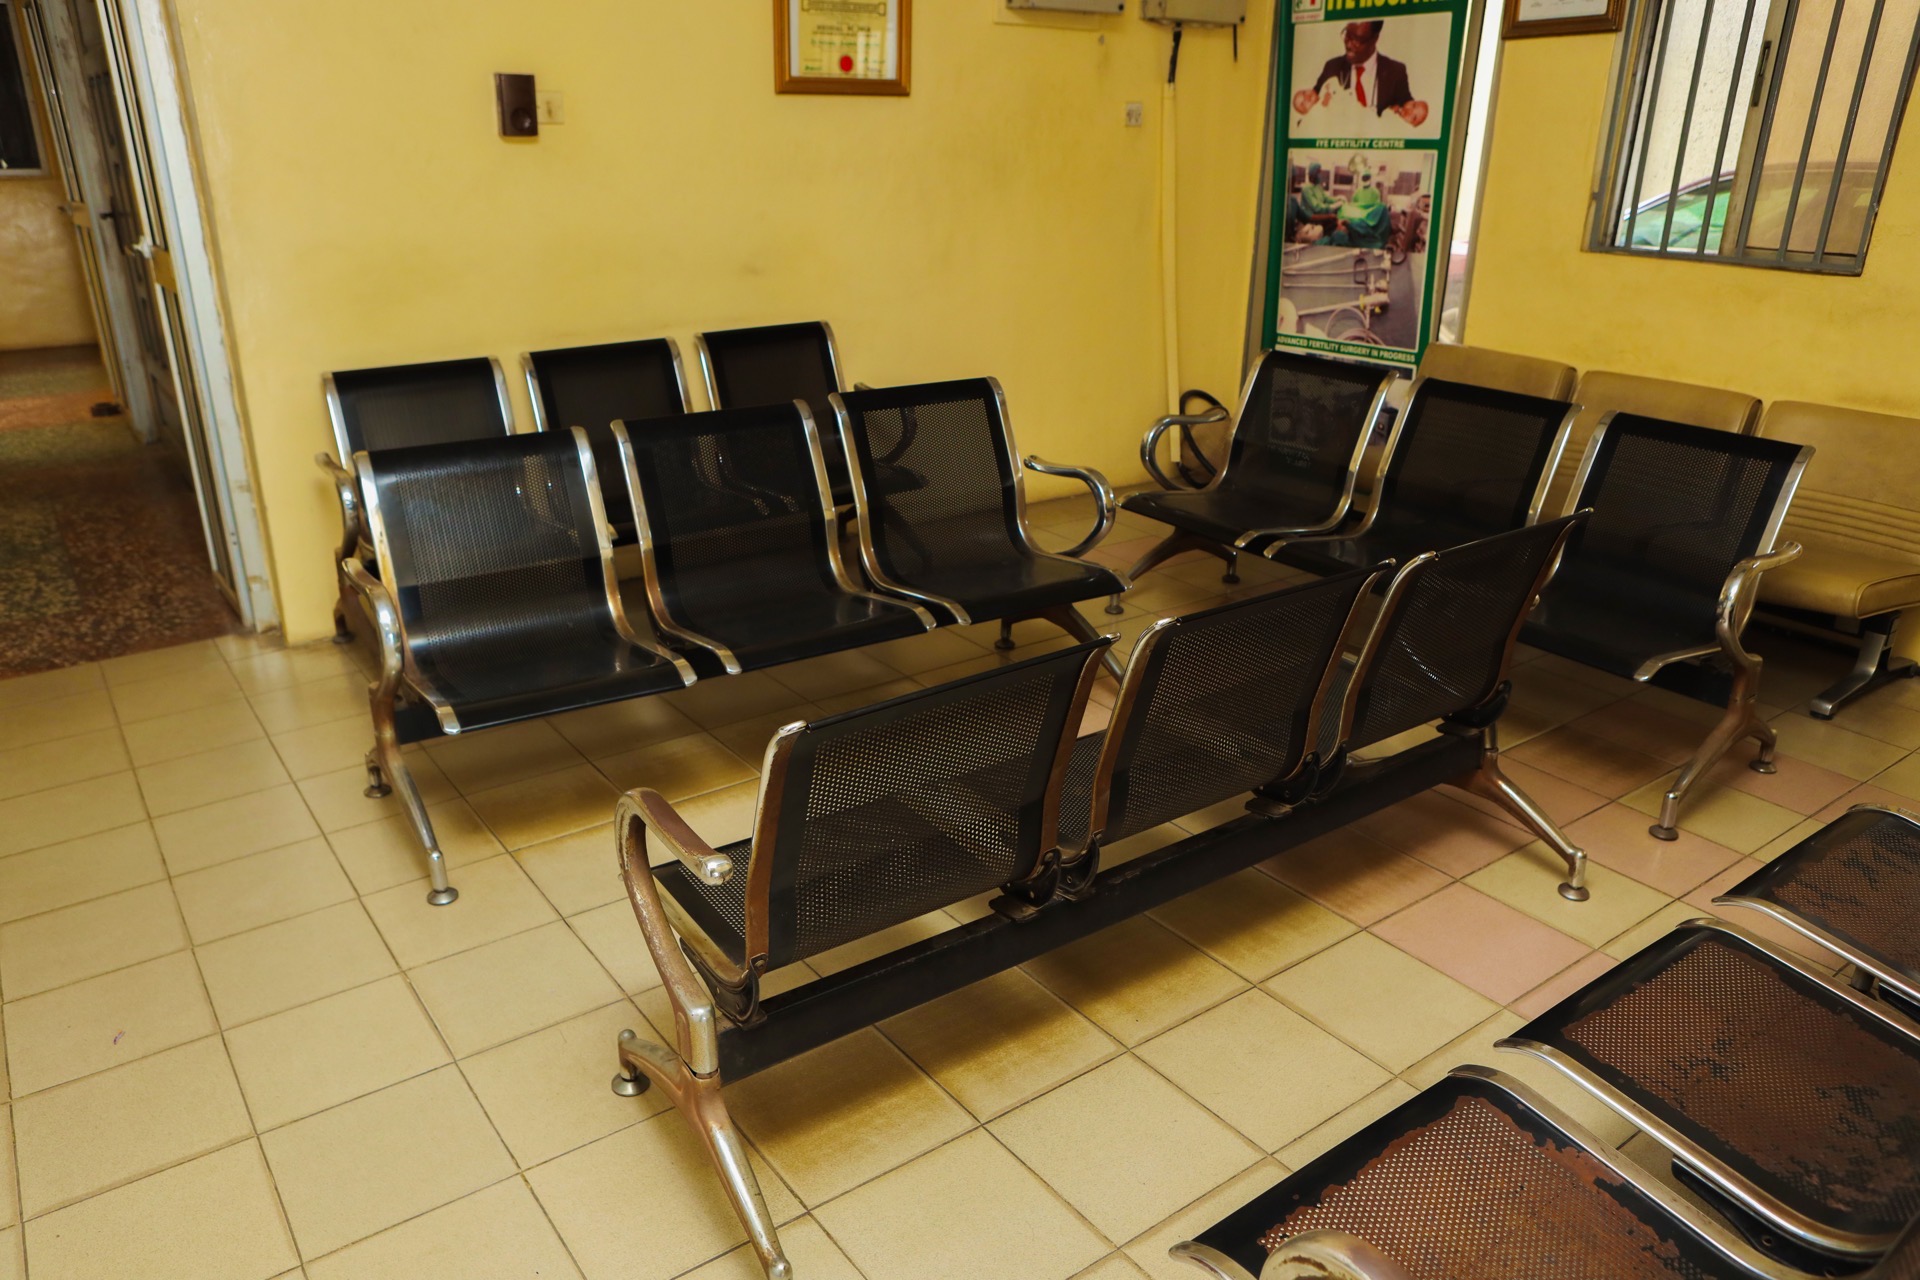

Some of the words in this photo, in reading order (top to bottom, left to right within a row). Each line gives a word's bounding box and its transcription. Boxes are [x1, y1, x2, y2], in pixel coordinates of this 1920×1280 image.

[1330, 139, 1370, 148] FERTILITY
[1372, 139, 1405, 149] CENTRE
[1277, 336, 1308, 346] ADVANCED
[1309, 339, 1339, 350] FERTILITY
[1340, 344, 1371, 356] SURGERY
[1371, 348, 1379, 357] IN
[1379, 350, 1416, 363] PROGRESS
